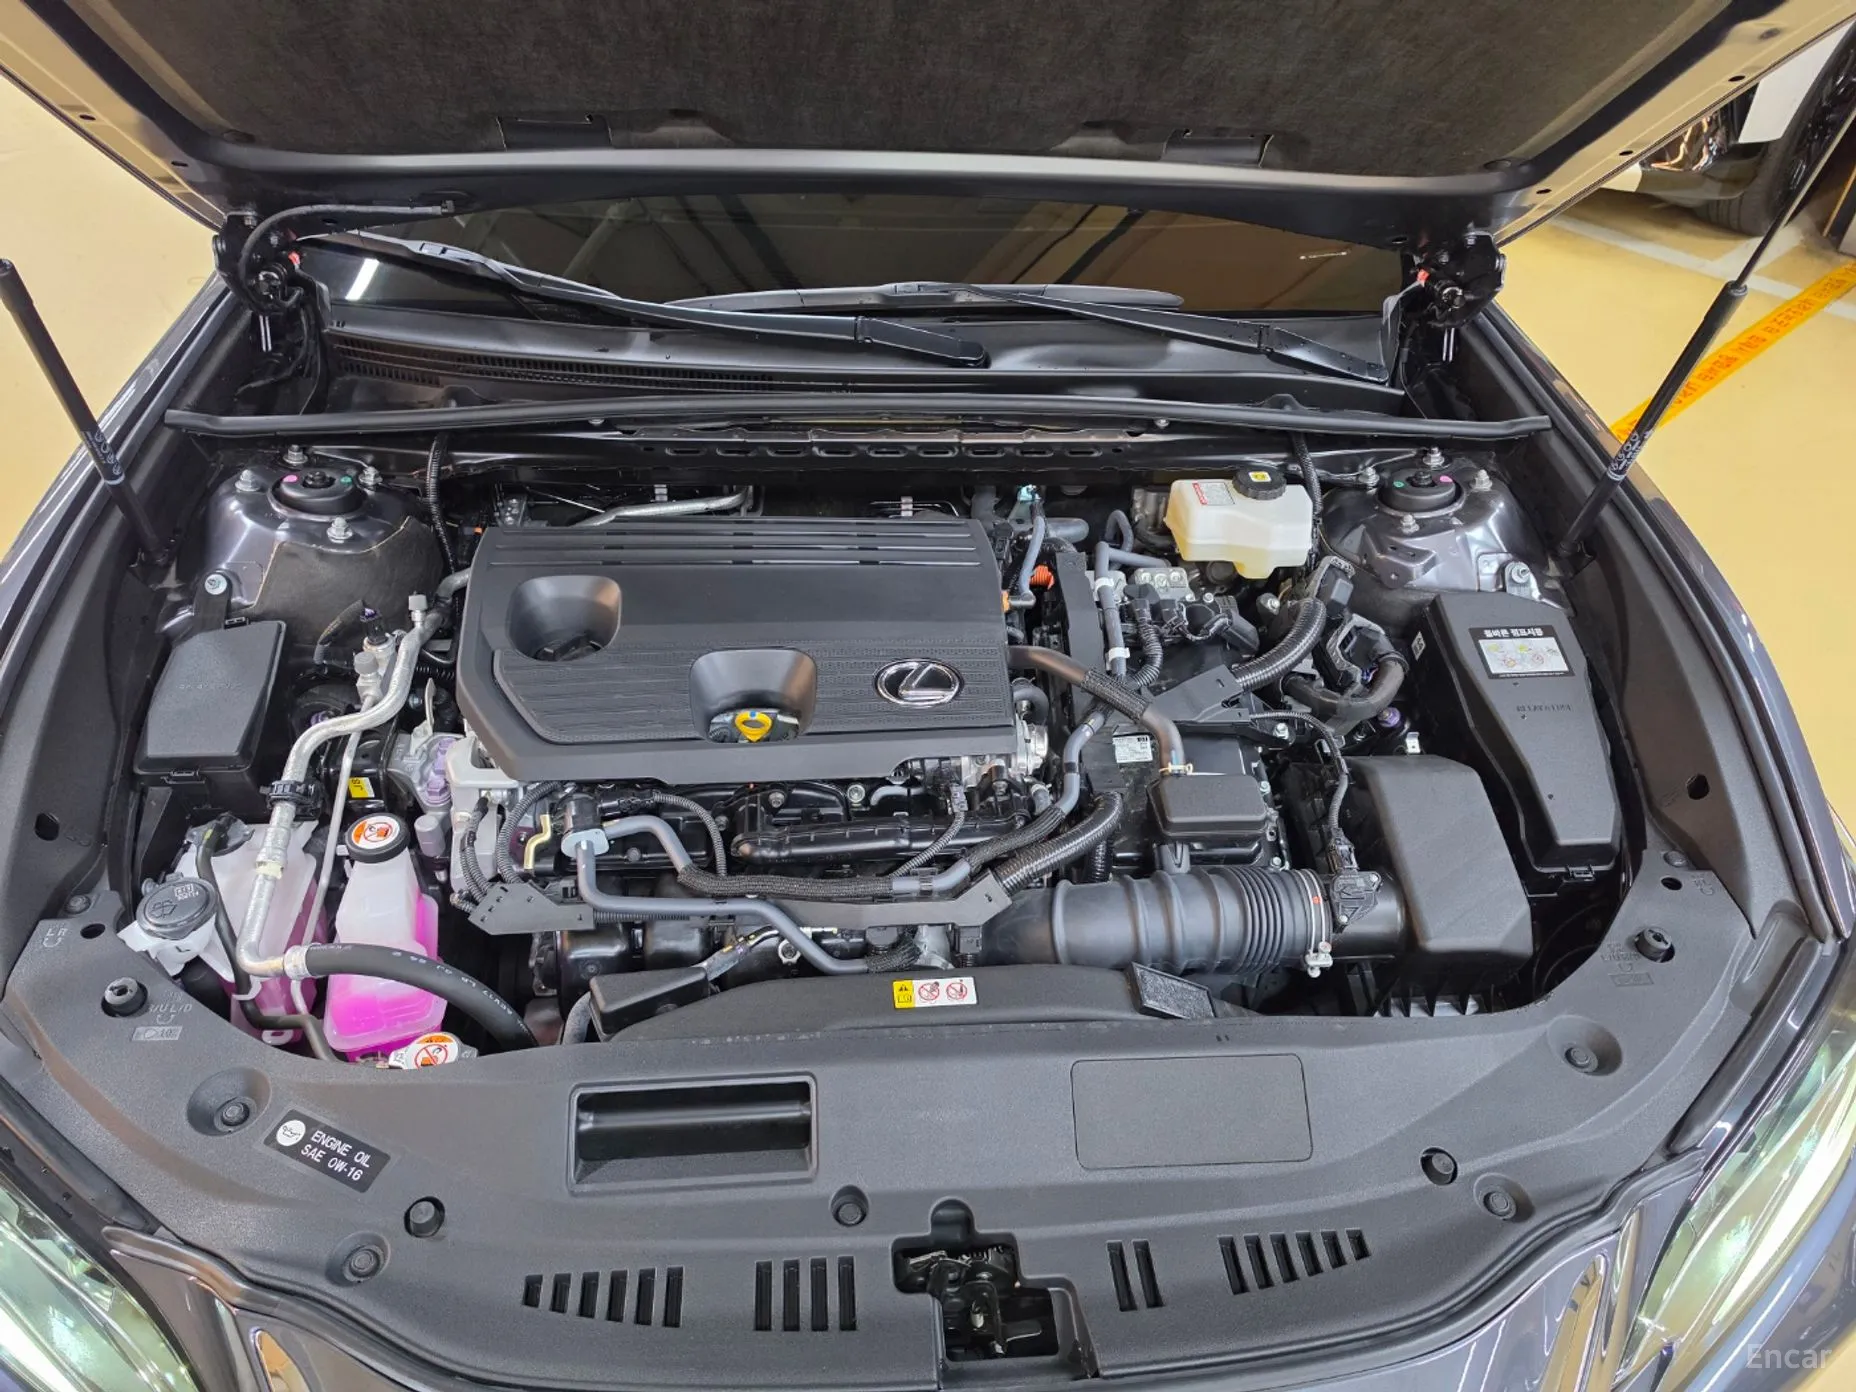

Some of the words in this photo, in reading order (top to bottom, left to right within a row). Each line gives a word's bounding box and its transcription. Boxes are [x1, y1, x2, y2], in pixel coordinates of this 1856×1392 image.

[300, 1144, 326, 1162] SAE
[327, 1157, 364, 1181] 0W-16
[311, 1130, 352, 1156] ENGINE
[353, 1151, 371, 1168] OIL
